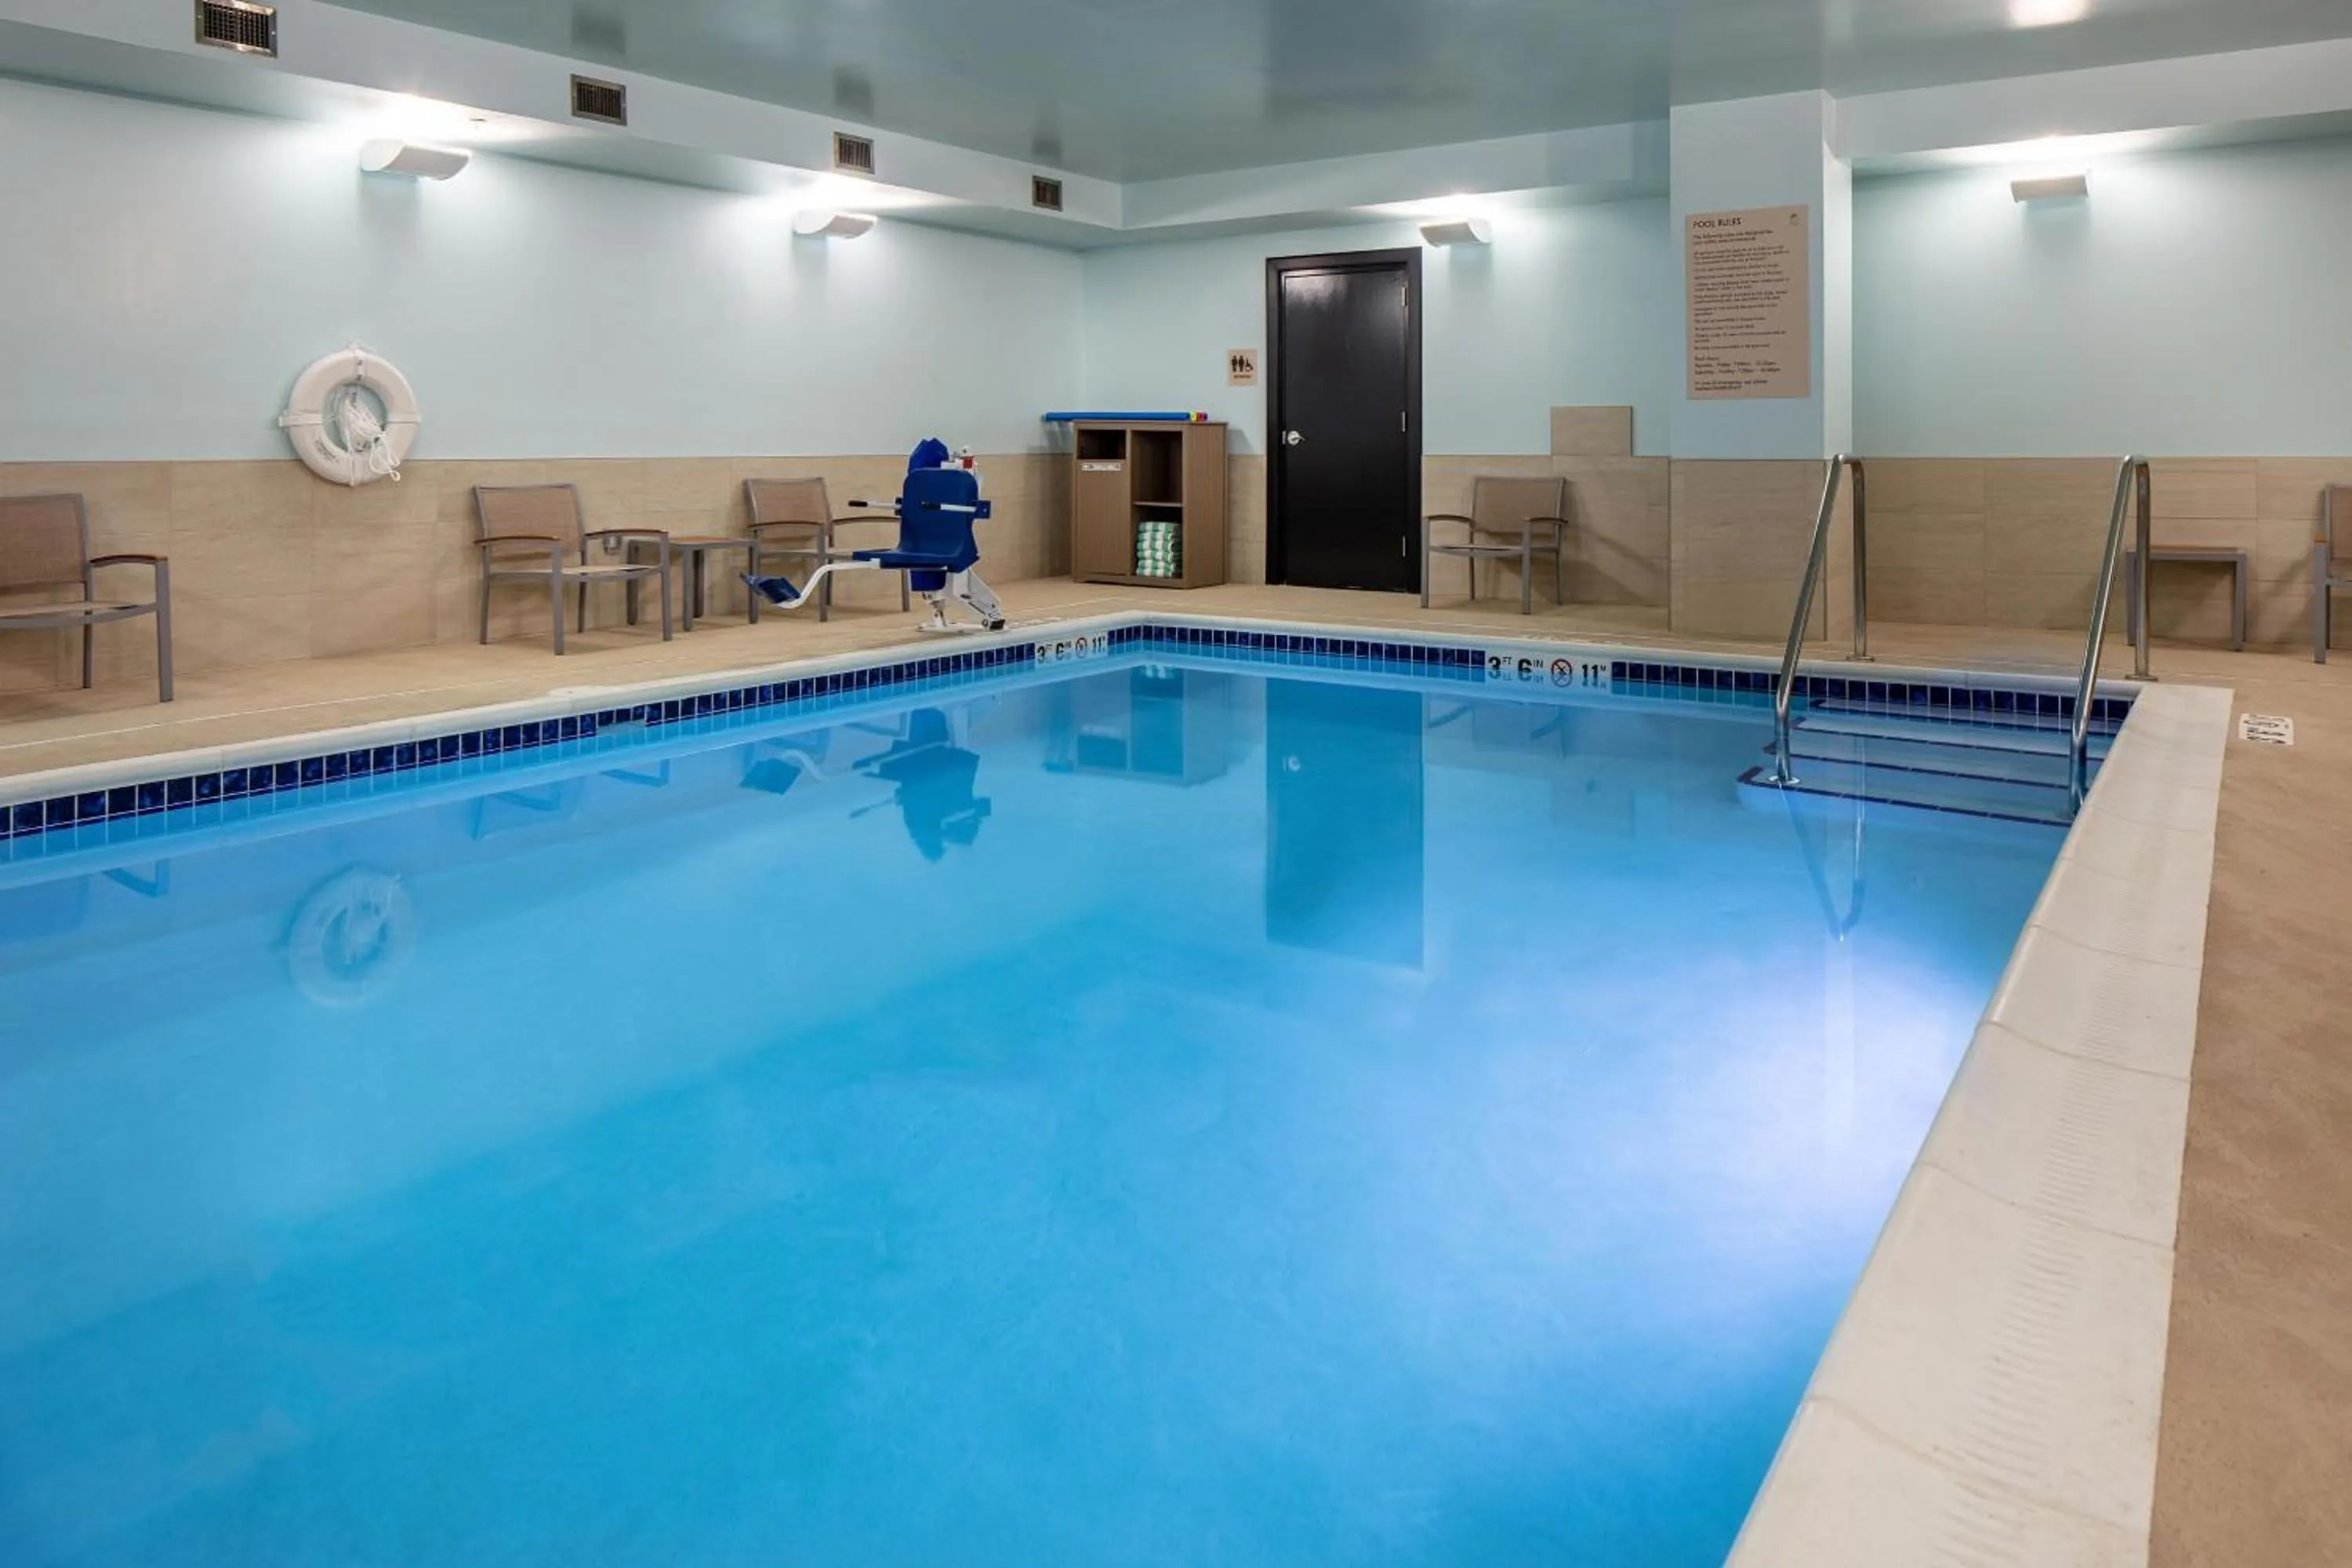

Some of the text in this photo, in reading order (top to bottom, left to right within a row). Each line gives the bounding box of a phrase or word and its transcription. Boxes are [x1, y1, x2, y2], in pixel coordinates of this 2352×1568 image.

[1693, 217, 1741, 229] POOL RULES
[1488, 656, 1501, 670] 3
[1503, 656, 1512, 665] FT
[1518, 659, 1532, 673] 6
[1534, 659, 1544, 668] IN
